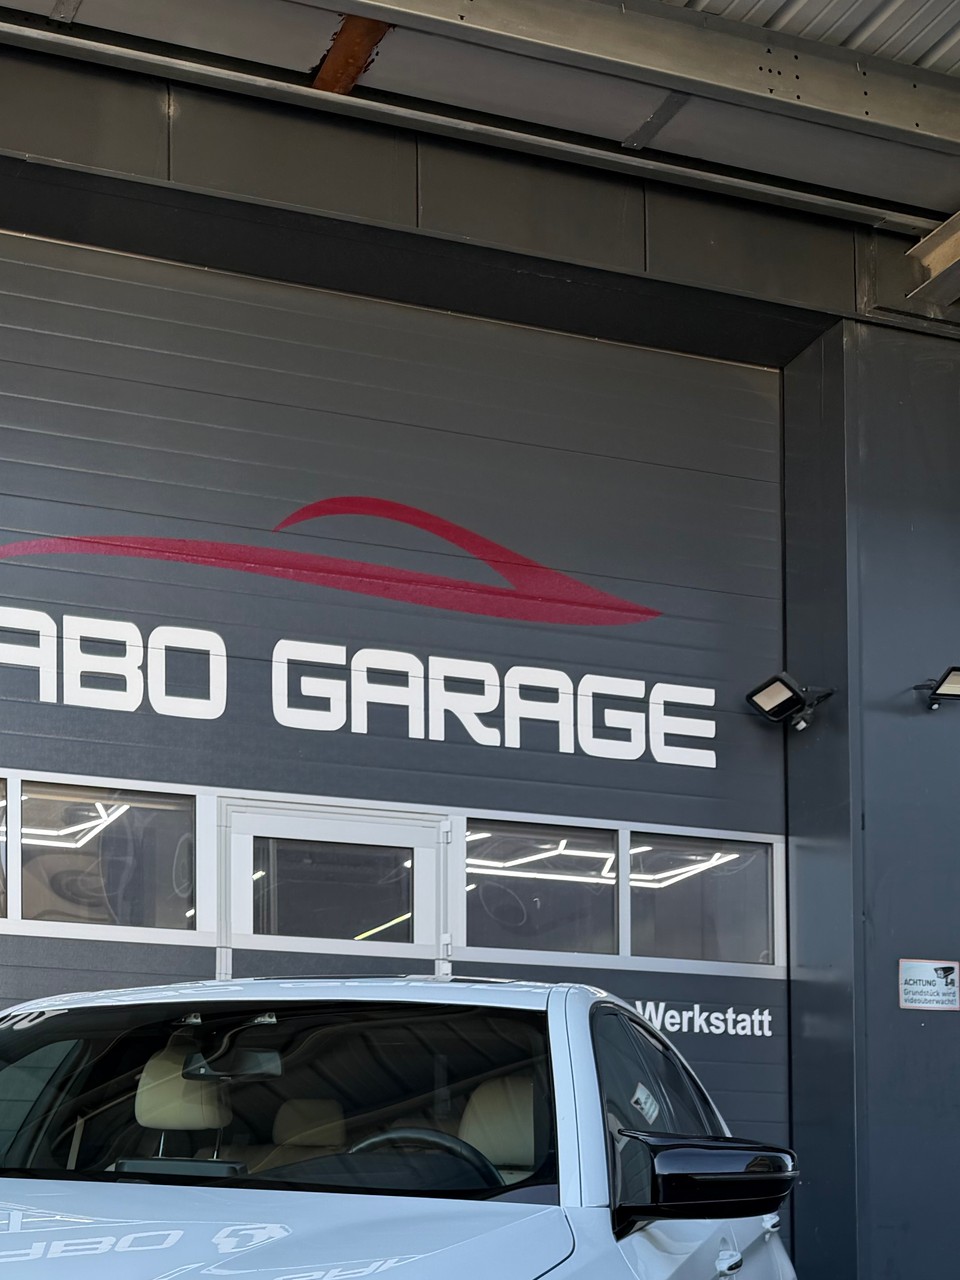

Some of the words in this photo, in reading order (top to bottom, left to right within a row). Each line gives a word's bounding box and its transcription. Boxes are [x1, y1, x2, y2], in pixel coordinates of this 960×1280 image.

[271, 638, 717, 769] GARAGE
[904, 978, 936, 987] ACHTUNG
[635, 1000, 773, 1037] Werkstatt
